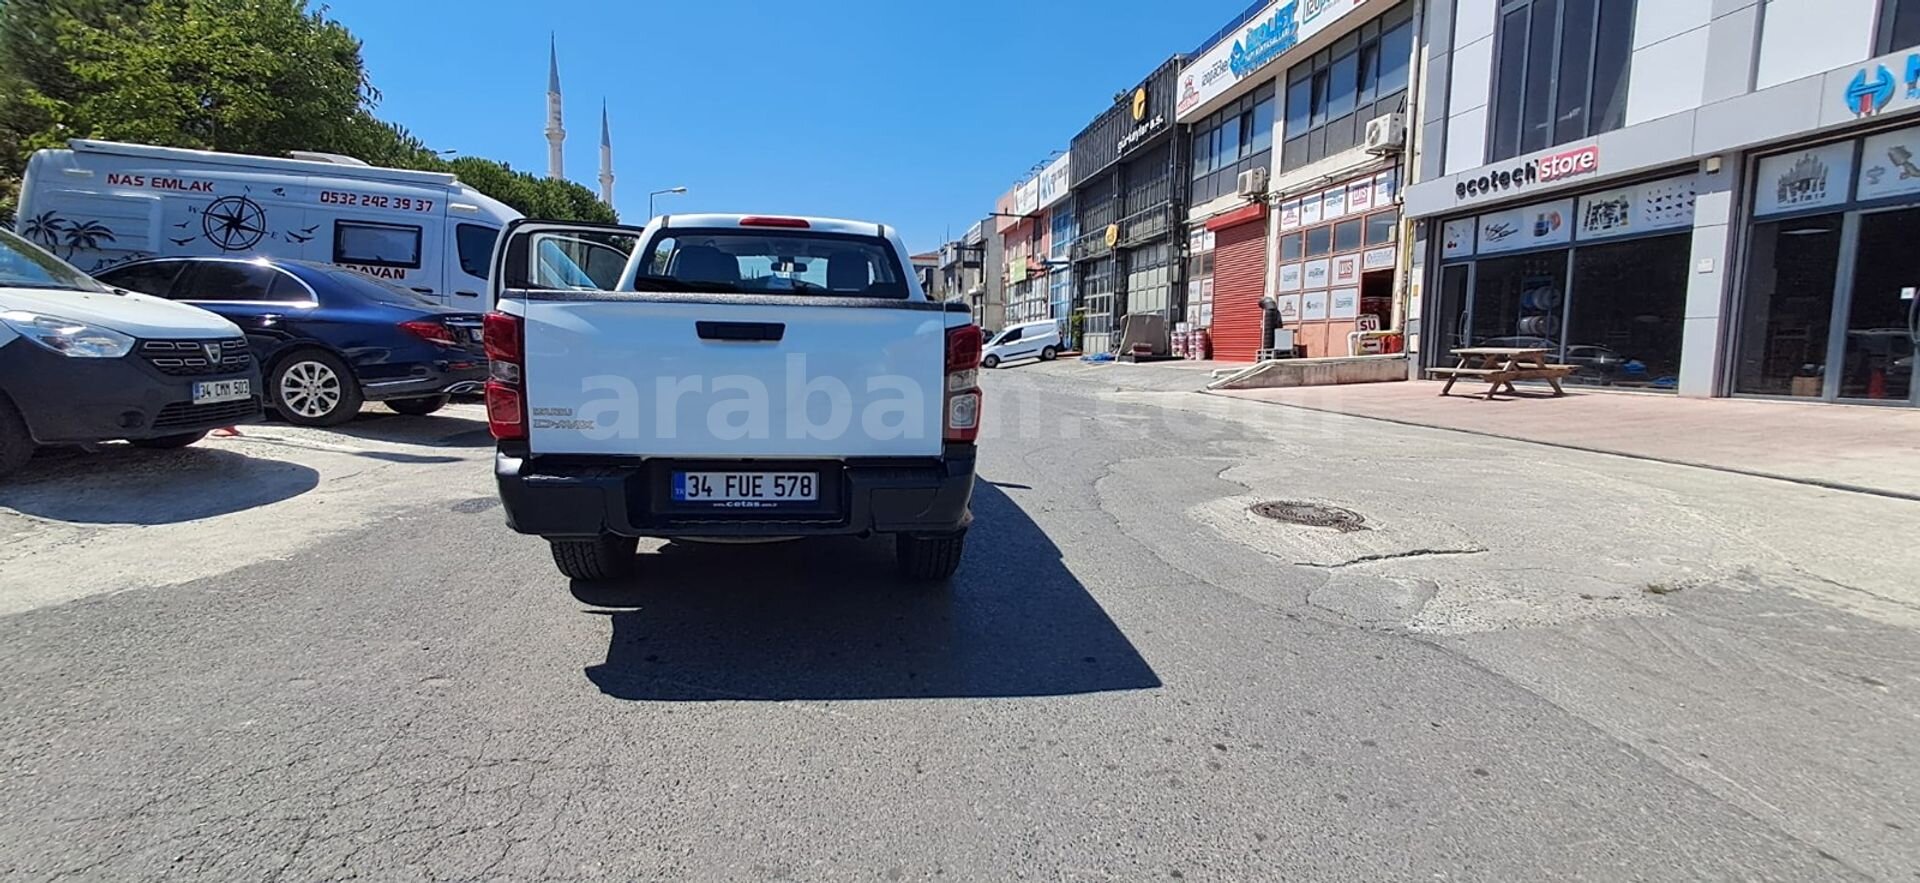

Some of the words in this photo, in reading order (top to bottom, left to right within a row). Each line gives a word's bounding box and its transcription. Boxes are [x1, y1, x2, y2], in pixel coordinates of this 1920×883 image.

[1540, 150, 1595, 178] store
[107, 173, 145, 187] NAS
[151, 176, 214, 193] EMLAK
[320, 190, 356, 205] 0532
[362, 194, 388, 208] 242
[393, 197, 411, 210] 39
[416, 199, 433, 212] 37
[1360, 319, 1377, 331] SU
[687, 474, 713, 498] 34
[725, 474, 764, 498] FUE
[773, 474, 812, 498] 578
